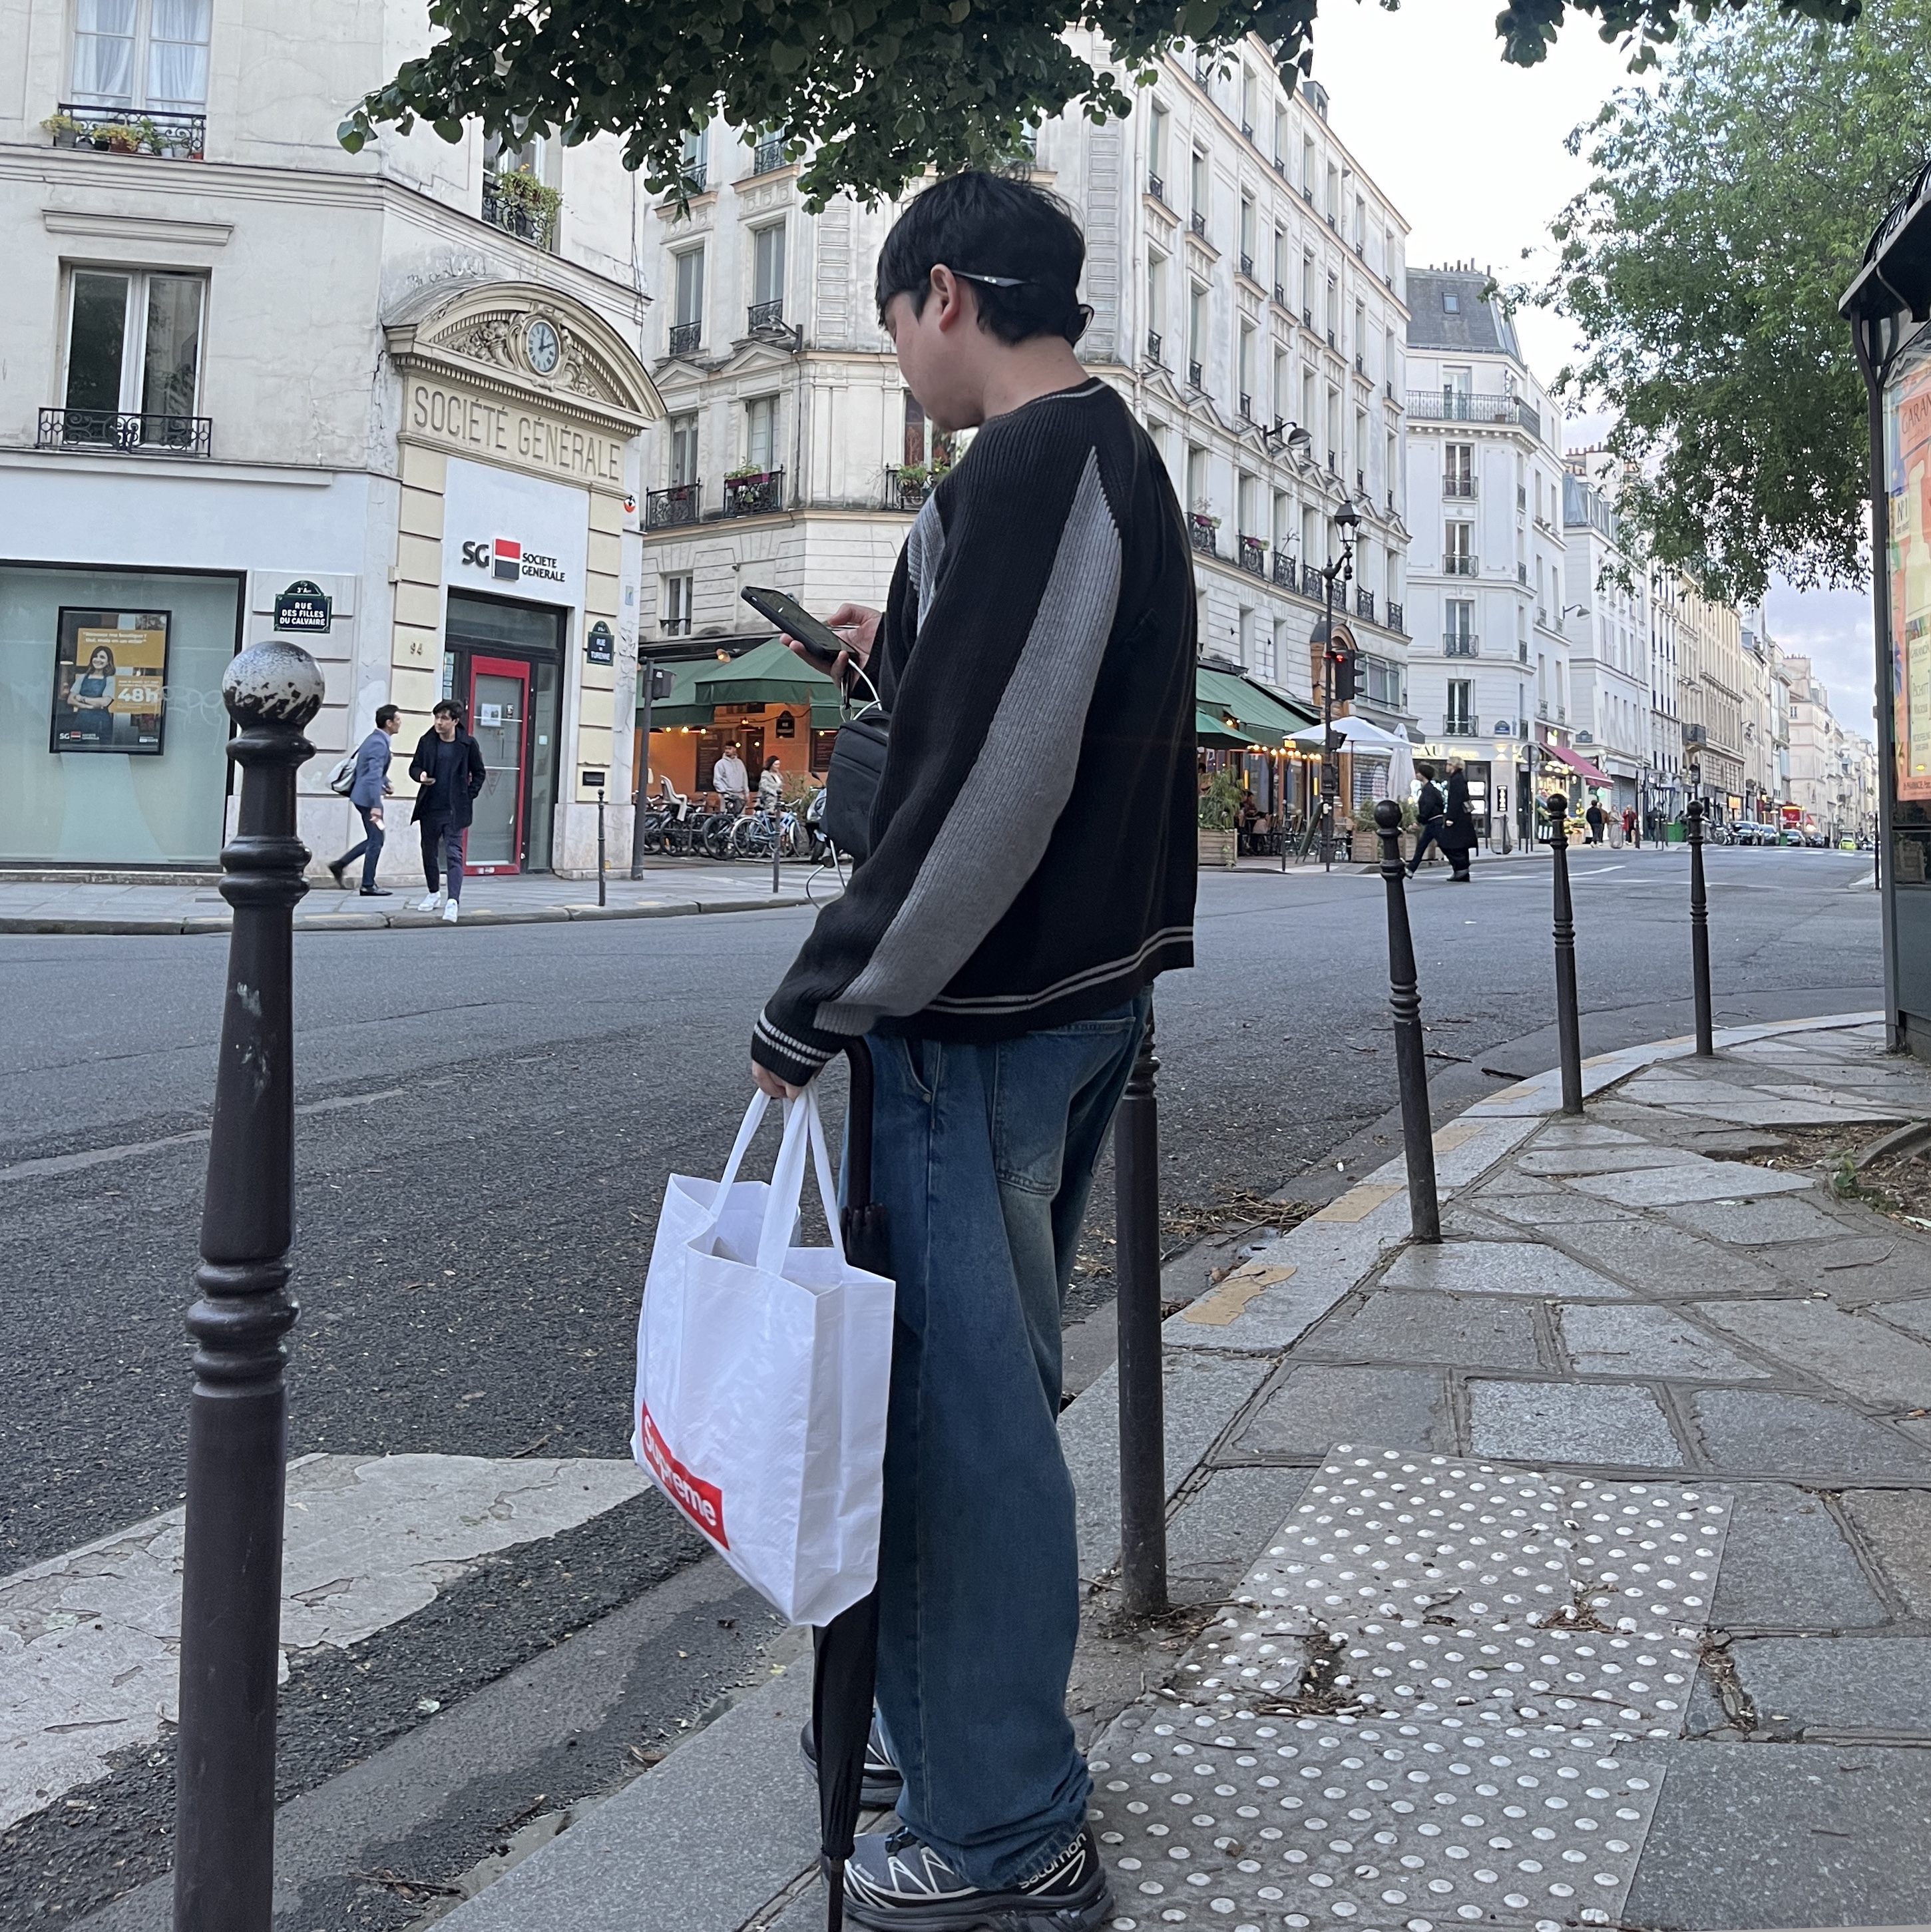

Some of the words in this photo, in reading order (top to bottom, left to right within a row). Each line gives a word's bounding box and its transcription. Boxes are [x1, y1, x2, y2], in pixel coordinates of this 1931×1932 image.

[414, 386, 508, 450] SOCIÉTÉ
[518, 417, 620, 481] GÉNÉRALE
[462, 541, 489, 569] SG
[522, 553, 557, 568] SOCIETE
[522, 565, 565, 582] GENERALE
[410, 642, 423, 656] 94
[118, 688, 158, 702] 48h
